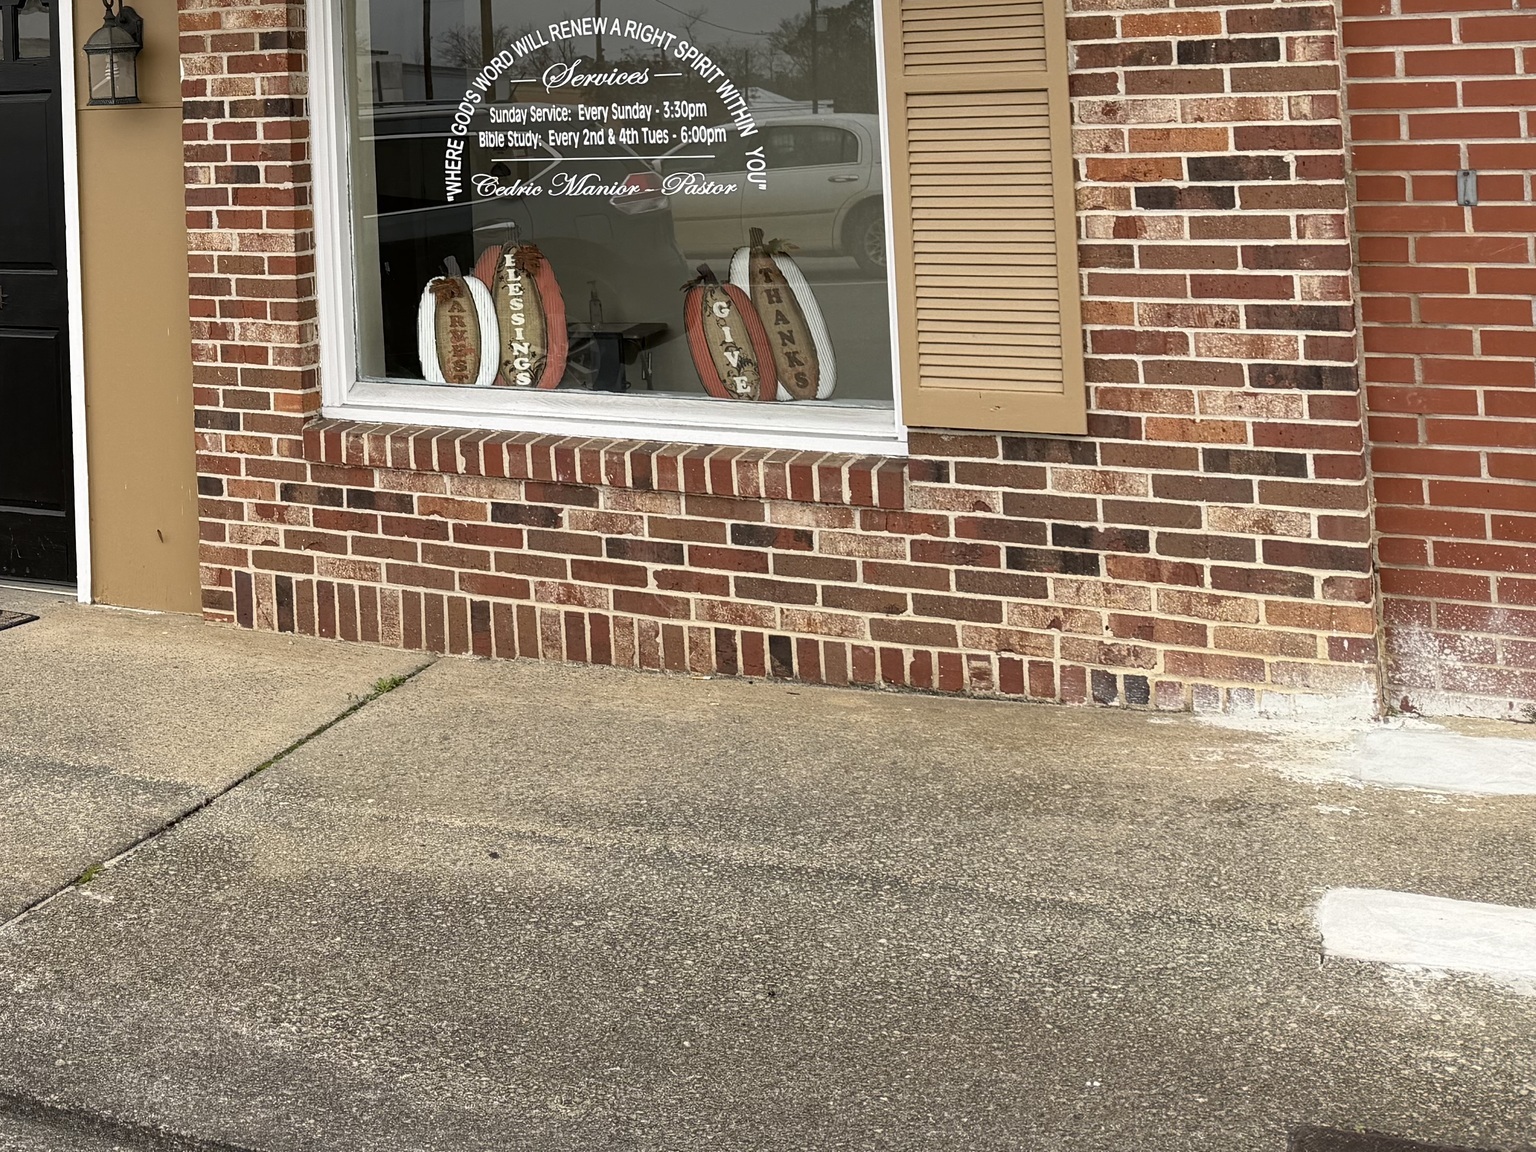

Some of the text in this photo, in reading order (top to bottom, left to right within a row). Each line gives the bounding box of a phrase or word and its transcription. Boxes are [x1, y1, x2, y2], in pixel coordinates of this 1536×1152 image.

[450, 89, 482, 136] GOD'S
[472, 50, 515, 92] WORD
[510, 29, 549, 58] WILL
[548, 17, 608, 42] RENEW
[609, 18, 622, 36] A
[624, 19, 677, 51] RIGHT
[673, 40, 725, 84] SPIRIT
[715, 78, 759, 138] WITHIN
[542, 59, 650, 94] Services
[478, 130, 505, 148] Bible
[507, 130, 543, 149] Study:
[548, 129, 580, 148] Every
[582, 128, 605, 146] 2nd
[607, 128, 616, 145] &
[619, 127, 639, 145] 4th
[641, 127, 670, 144] Tues
[680, 125, 727, 146] 6:00pm
[489, 106, 528, 126] Sunday
[530, 104, 572, 122] Service:
[577, 104, 609, 123] Every
[611, 102, 652, 122] Sunday
[663, 100, 708, 121] 3:30pm
[471, 173, 544, 197] Cedric
[548, 172, 641, 196] Manior
[660, 172, 738, 196] Pastor
[448, 300, 469, 384] ARVEST
[712, 301, 751, 394] GIVE
[759, 267, 809, 389] THANKS
